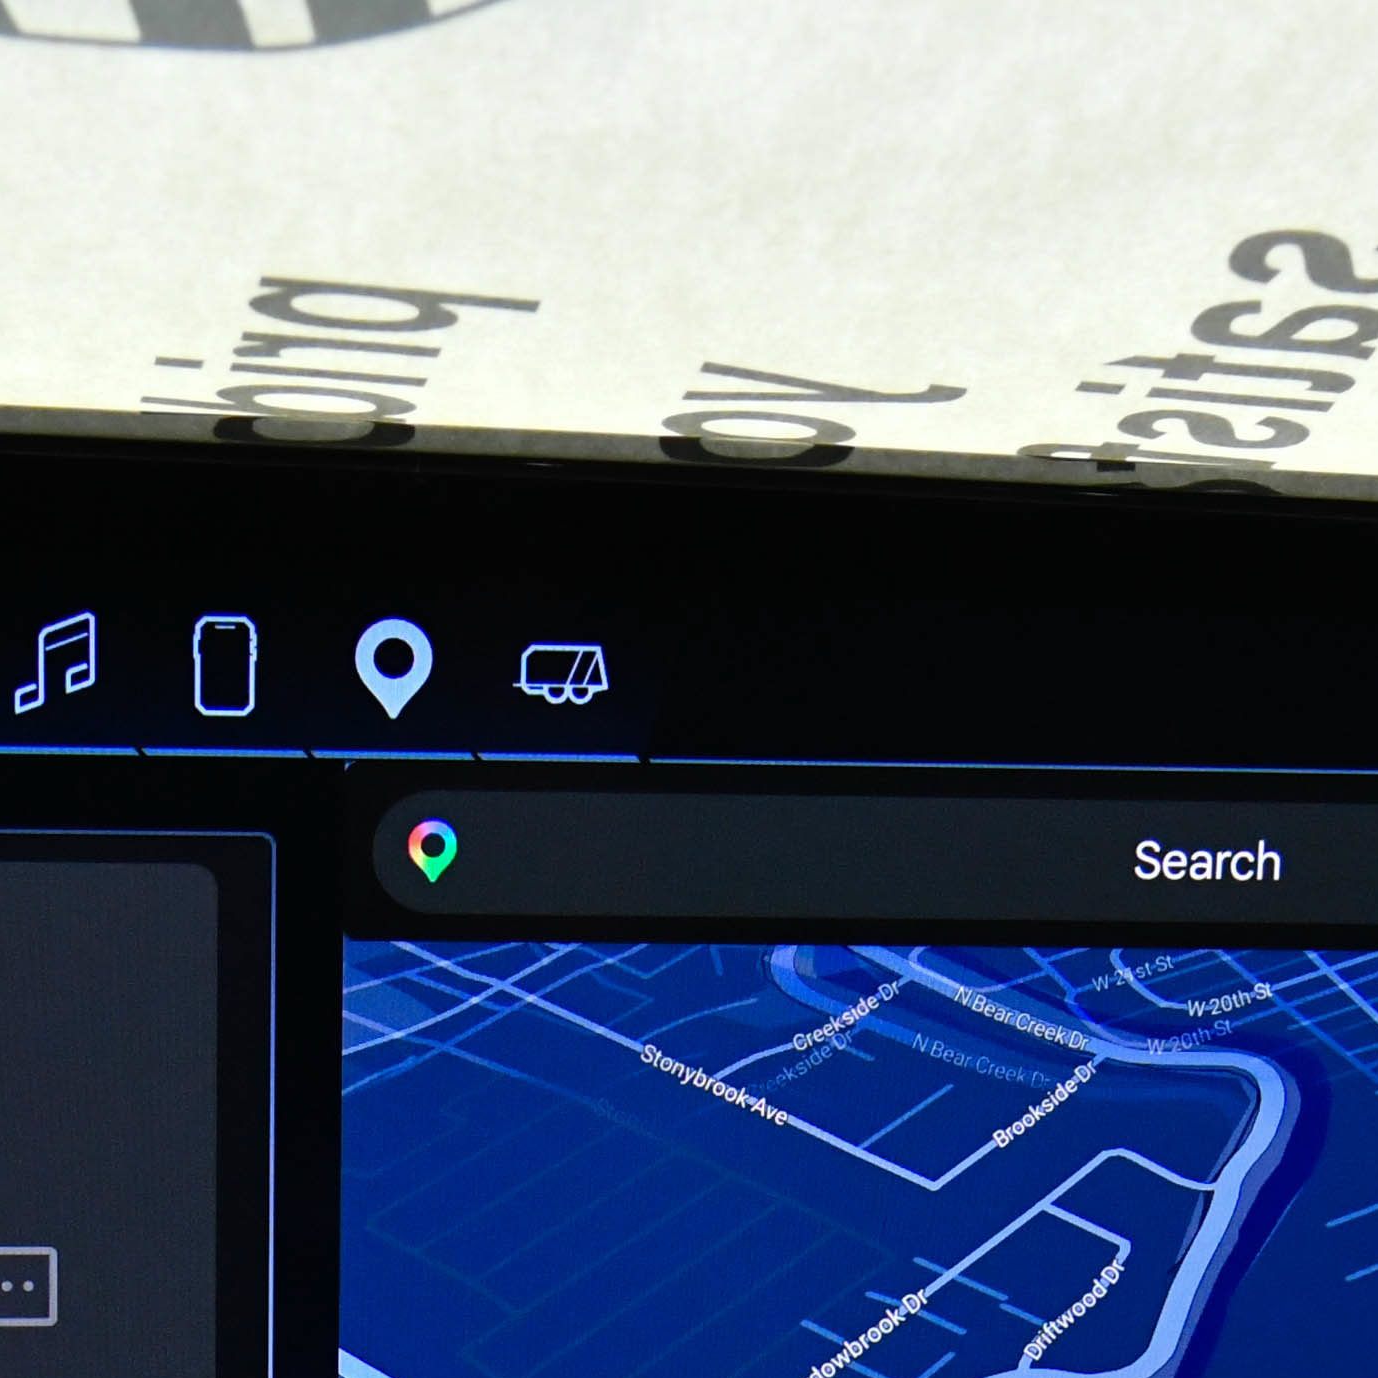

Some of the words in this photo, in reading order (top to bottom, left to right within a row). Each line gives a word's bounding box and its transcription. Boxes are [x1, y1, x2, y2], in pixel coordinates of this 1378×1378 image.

[1134, 839, 1282, 881] Search
[1155, 954, 1175, 972] St
[792, 988, 880, 1053] Creekside
[876, 977, 902, 1002] Dr
[954, 985, 973, 1008] N
[971, 994, 1013, 1025] Bear
[1016, 1012, 1068, 1046] Creek
[1067, 1027, 1091, 1051] Dr
[1186, 999, 1207, 1017] W
[1210, 988, 1252, 1014] 20th
[1253, 981, 1274, 999] St
[1213, 1018, 1233, 1037] St
[928, 1041, 974, 1070] Bear
[974, 1054, 1027, 1084] Creek
[639, 1042, 752, 1111] Stonybrook
[749, 1093, 790, 1128] Ave
[991, 1078, 1080, 1149] Brookside
[1072, 1057, 1099, 1085] Dr
[901, 1286, 930, 1315] Dr
[1023, 1277, 1112, 1363] Driftwood
[1099, 1258, 1127, 1289] Dr
